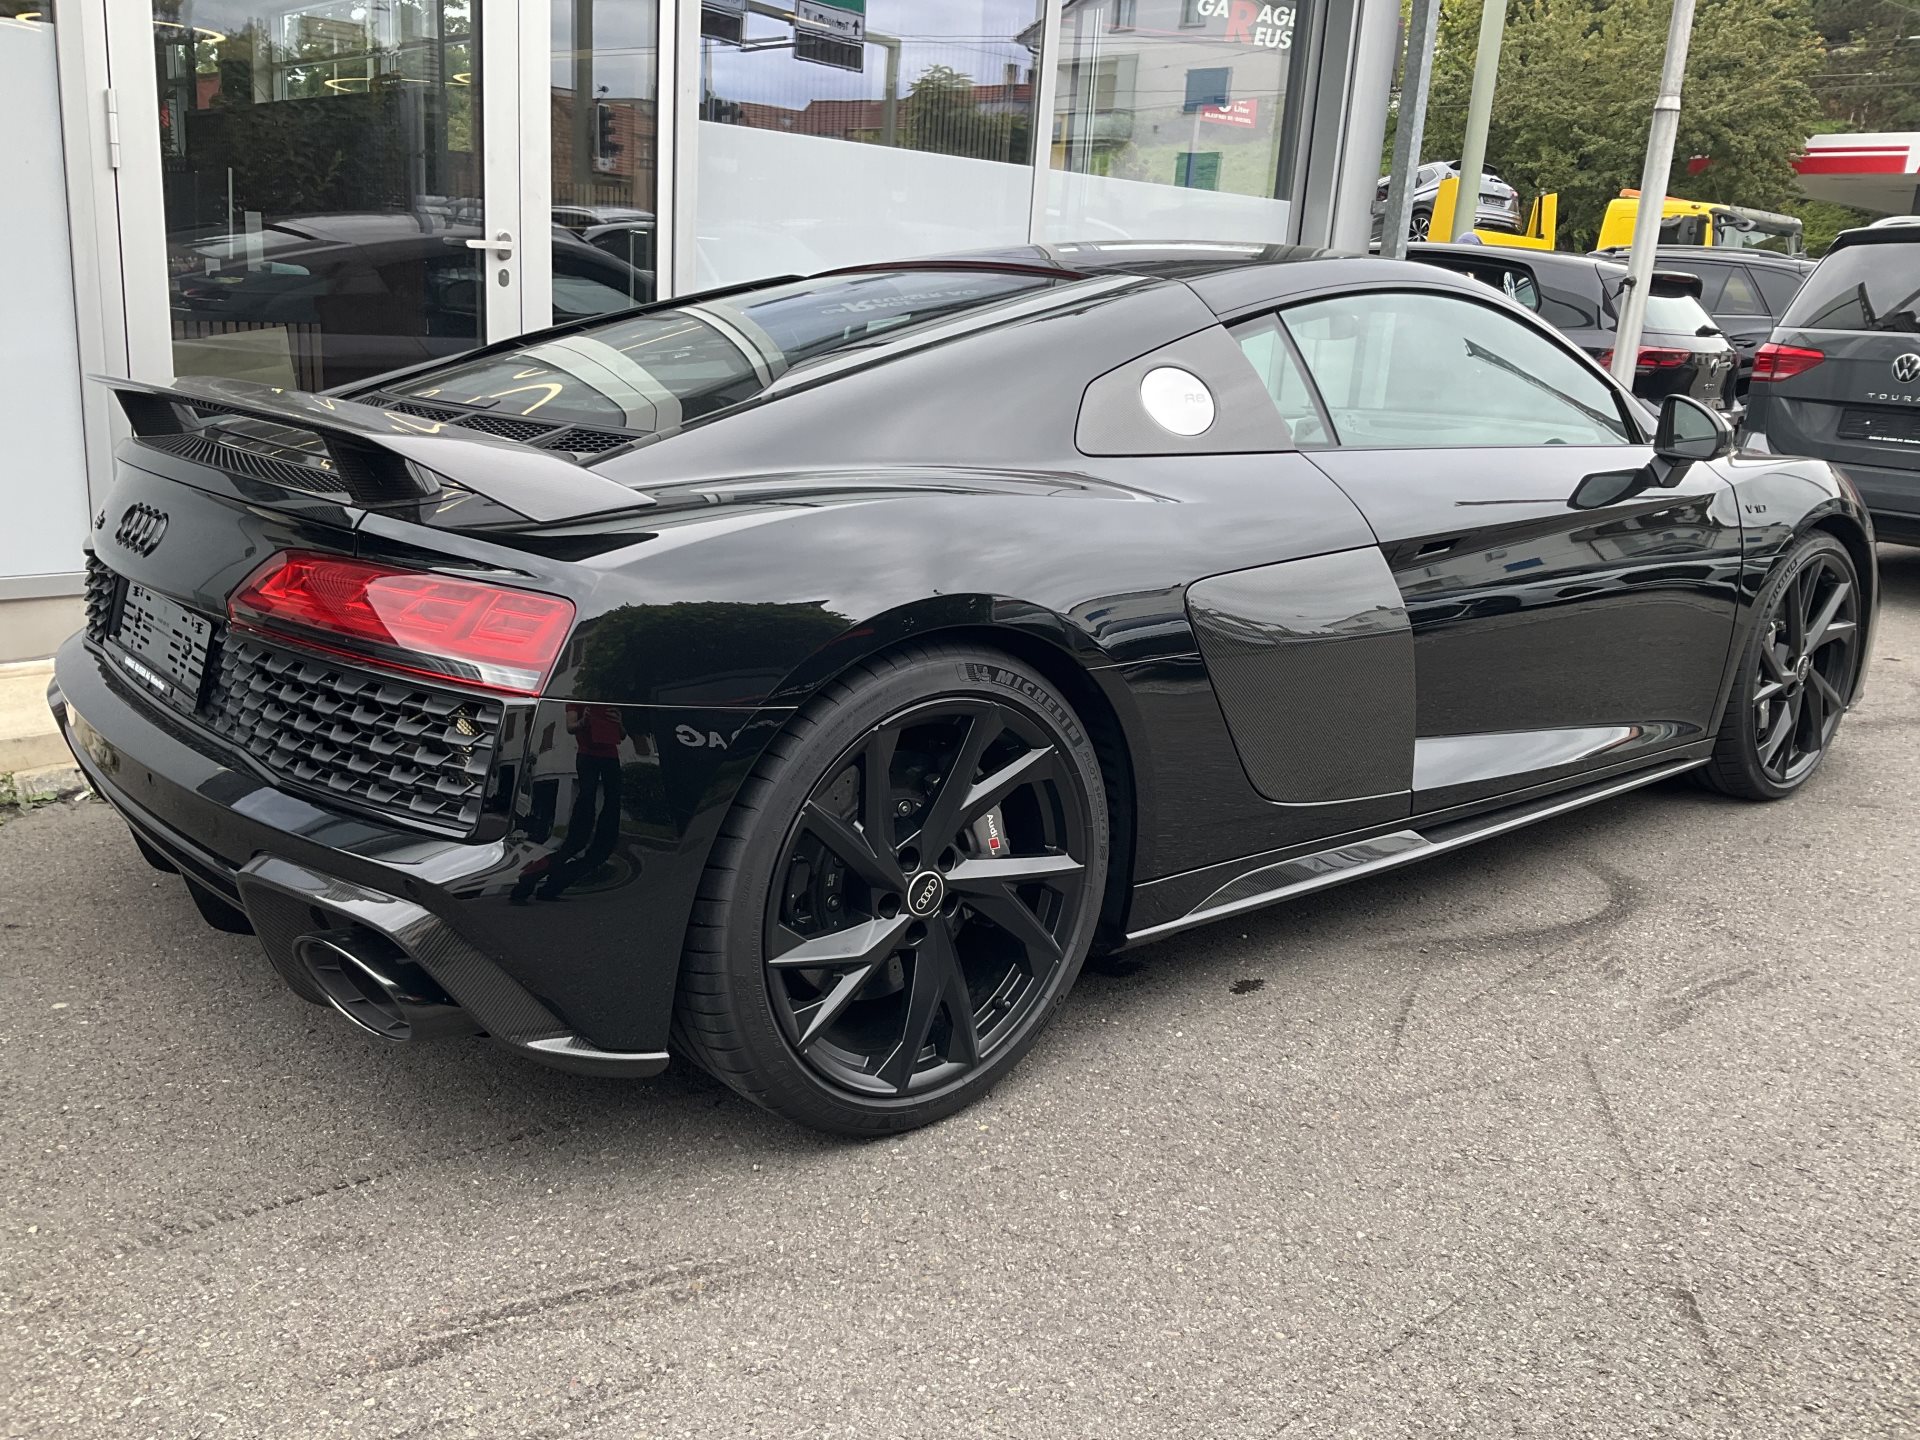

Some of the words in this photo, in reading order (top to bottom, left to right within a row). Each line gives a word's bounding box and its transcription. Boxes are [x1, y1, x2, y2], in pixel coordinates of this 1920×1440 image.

[1234, 105, 1250, 114] Liter
[1184, 393, 1206, 404] R8
[1745, 504, 1767, 514] V10
[995, 669, 1080, 742] MICHELIN
[1083, 752, 1098, 782] PILOT
[986, 814, 998, 837] Audi
